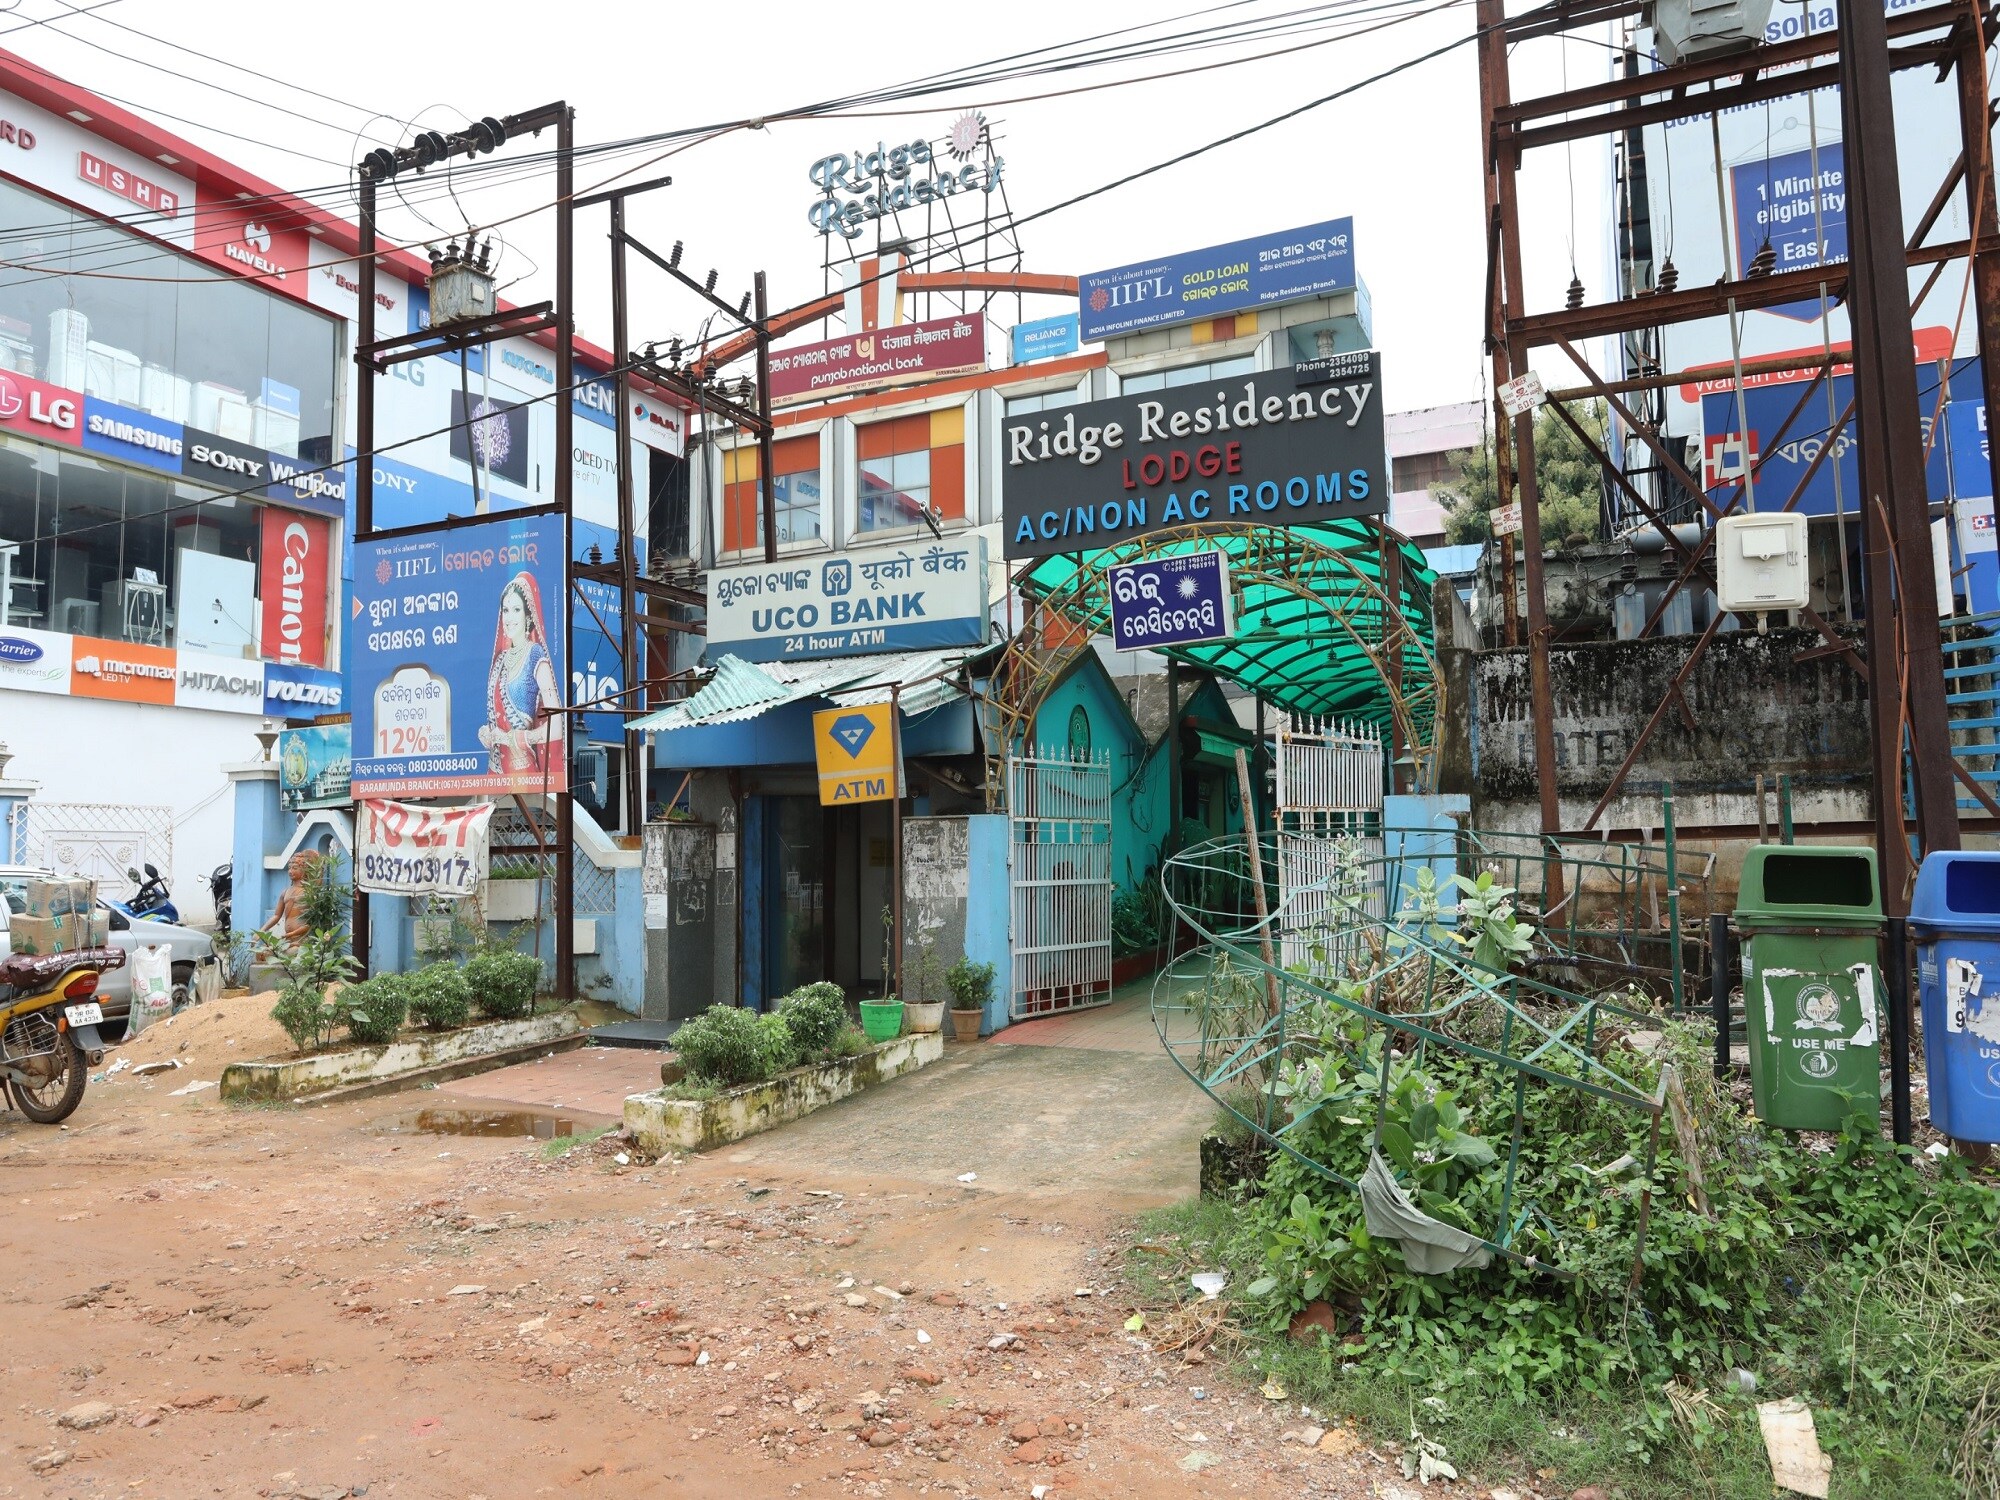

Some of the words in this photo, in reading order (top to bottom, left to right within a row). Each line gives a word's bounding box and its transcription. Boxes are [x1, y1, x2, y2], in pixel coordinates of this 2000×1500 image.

[808, 138, 932, 194] Ridge
[82, 154, 177, 216] USHA
[808, 156, 1005, 240] Residency
[1757, 183, 1766, 201] 1
[1774, 168, 1843, 198] Minute
[1756, 191, 1847, 226] eligibility
[225, 243, 287, 280] HAVELLS
[1782, 238, 1829, 262] Easy
[1089, 275, 1110, 289] When
[1123, 268, 1143, 281] about
[1183, 269, 1215, 285] GOLD
[1217, 262, 1249, 279] LOAN
[1260, 290, 1279, 300] Ridge
[1279, 284, 1312, 297] Residency
[1313, 278, 1336, 289] Branch
[1110, 276, 1173, 308] IIFL
[882, 334, 912, 351] पंजाब
[953, 320, 973, 339] बैंक
[1089, 325, 1106, 335] INDIA
[1106, 319, 1133, 332] INFOLINE
[1133, 314, 1159, 327] FINANCE
[1160, 309, 1185, 322] LIMITED
[392, 349, 425, 387] LG
[811, 368, 848, 388] punjab
[848, 354, 894, 379] national
[895, 354, 924, 370] bank
[1329, 363, 1370, 379] 2354725
[29, 391, 76, 429] LG
[1008, 413, 1123, 466] Ridge
[1138, 381, 1373, 443] Residency
[89, 415, 182, 455] SAMSUNG
[191, 445, 263, 478] SONY
[1123, 440, 1243, 489] LODGE
[269, 460, 345, 500] Whirlpool
[373, 467, 417, 494] ONY
[1015, 497, 1147, 544] AC/NON
[1163, 489, 1211, 524] AC
[1228, 469, 1371, 515] ROOMS
[396, 557, 436, 579] IIFL
[859, 551, 914, 590] यूको
[919, 546, 970, 575] बैंक
[282, 522, 309, 662] Canon
[369, 598, 397, 627] ସୁନା
[752, 604, 819, 633] UCO
[830, 591, 926, 626] BANK
[785, 637, 804, 652] 24
[808, 635, 844, 651] hour
[849, 629, 885, 647] ATM
[17, 666, 47, 678] experts
[102, 673, 118, 682] LED
[119, 675, 131, 683] TV
[103, 660, 176, 681] micromax
[181, 670, 262, 696] HITACHI
[267, 680, 342, 706] VOLTAS
[408, 758, 478, 773] 08030088400
[359, 780, 407, 793] BARAMUNDA
[833, 778, 886, 801] ATM
[365, 798, 409, 848] TO
[365, 854, 470, 886] 9337103917
[1792, 1038, 1820, 1049] USE
[1824, 1039, 1846, 1051] ME
